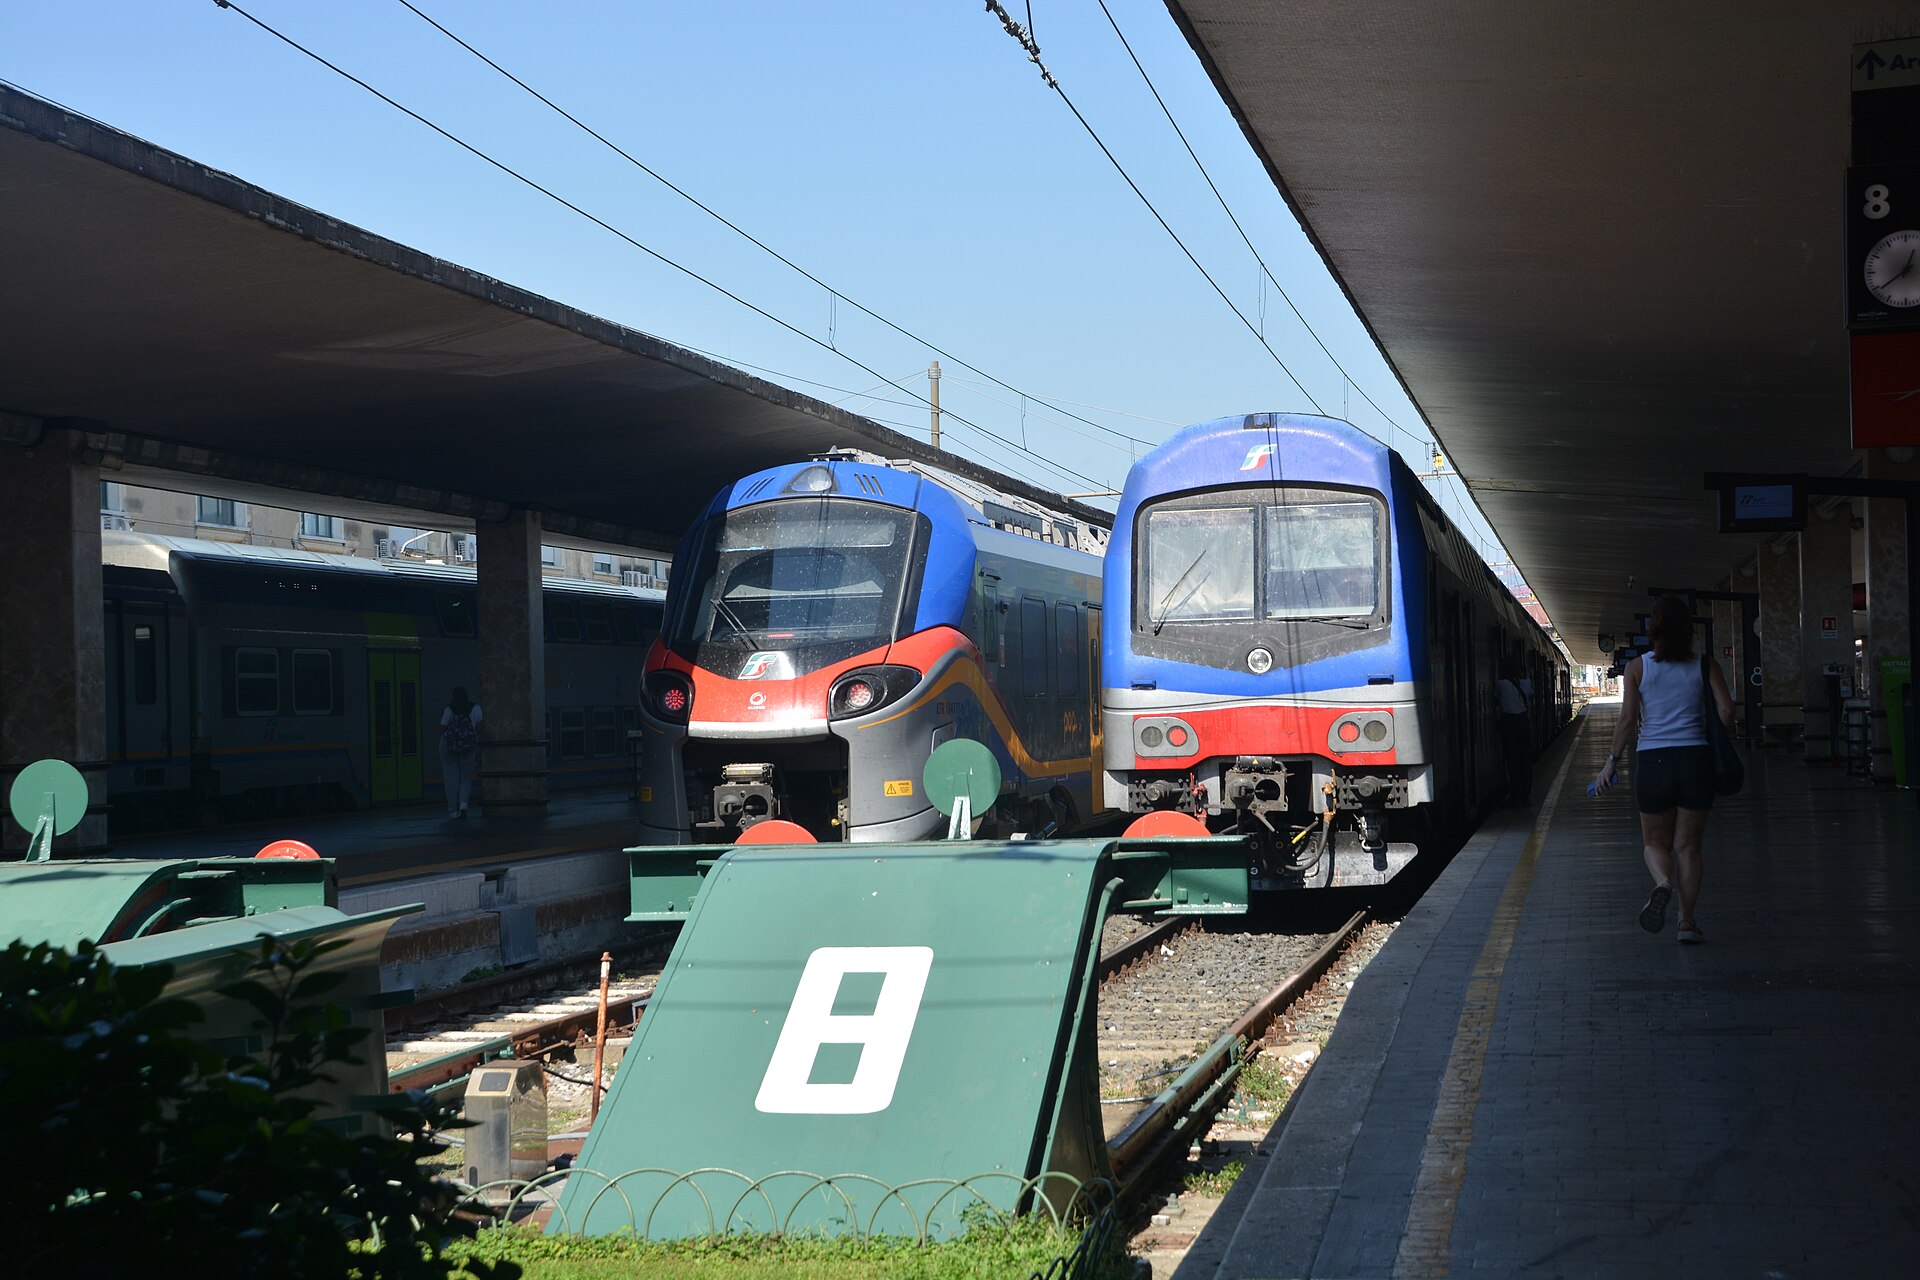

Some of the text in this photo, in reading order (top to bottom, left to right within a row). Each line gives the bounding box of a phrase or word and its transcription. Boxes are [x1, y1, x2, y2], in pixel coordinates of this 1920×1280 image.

[1889, 54, 1920, 71] Ar
[1862, 183, 1891, 220] 8
[755, 946, 934, 1114] 8
